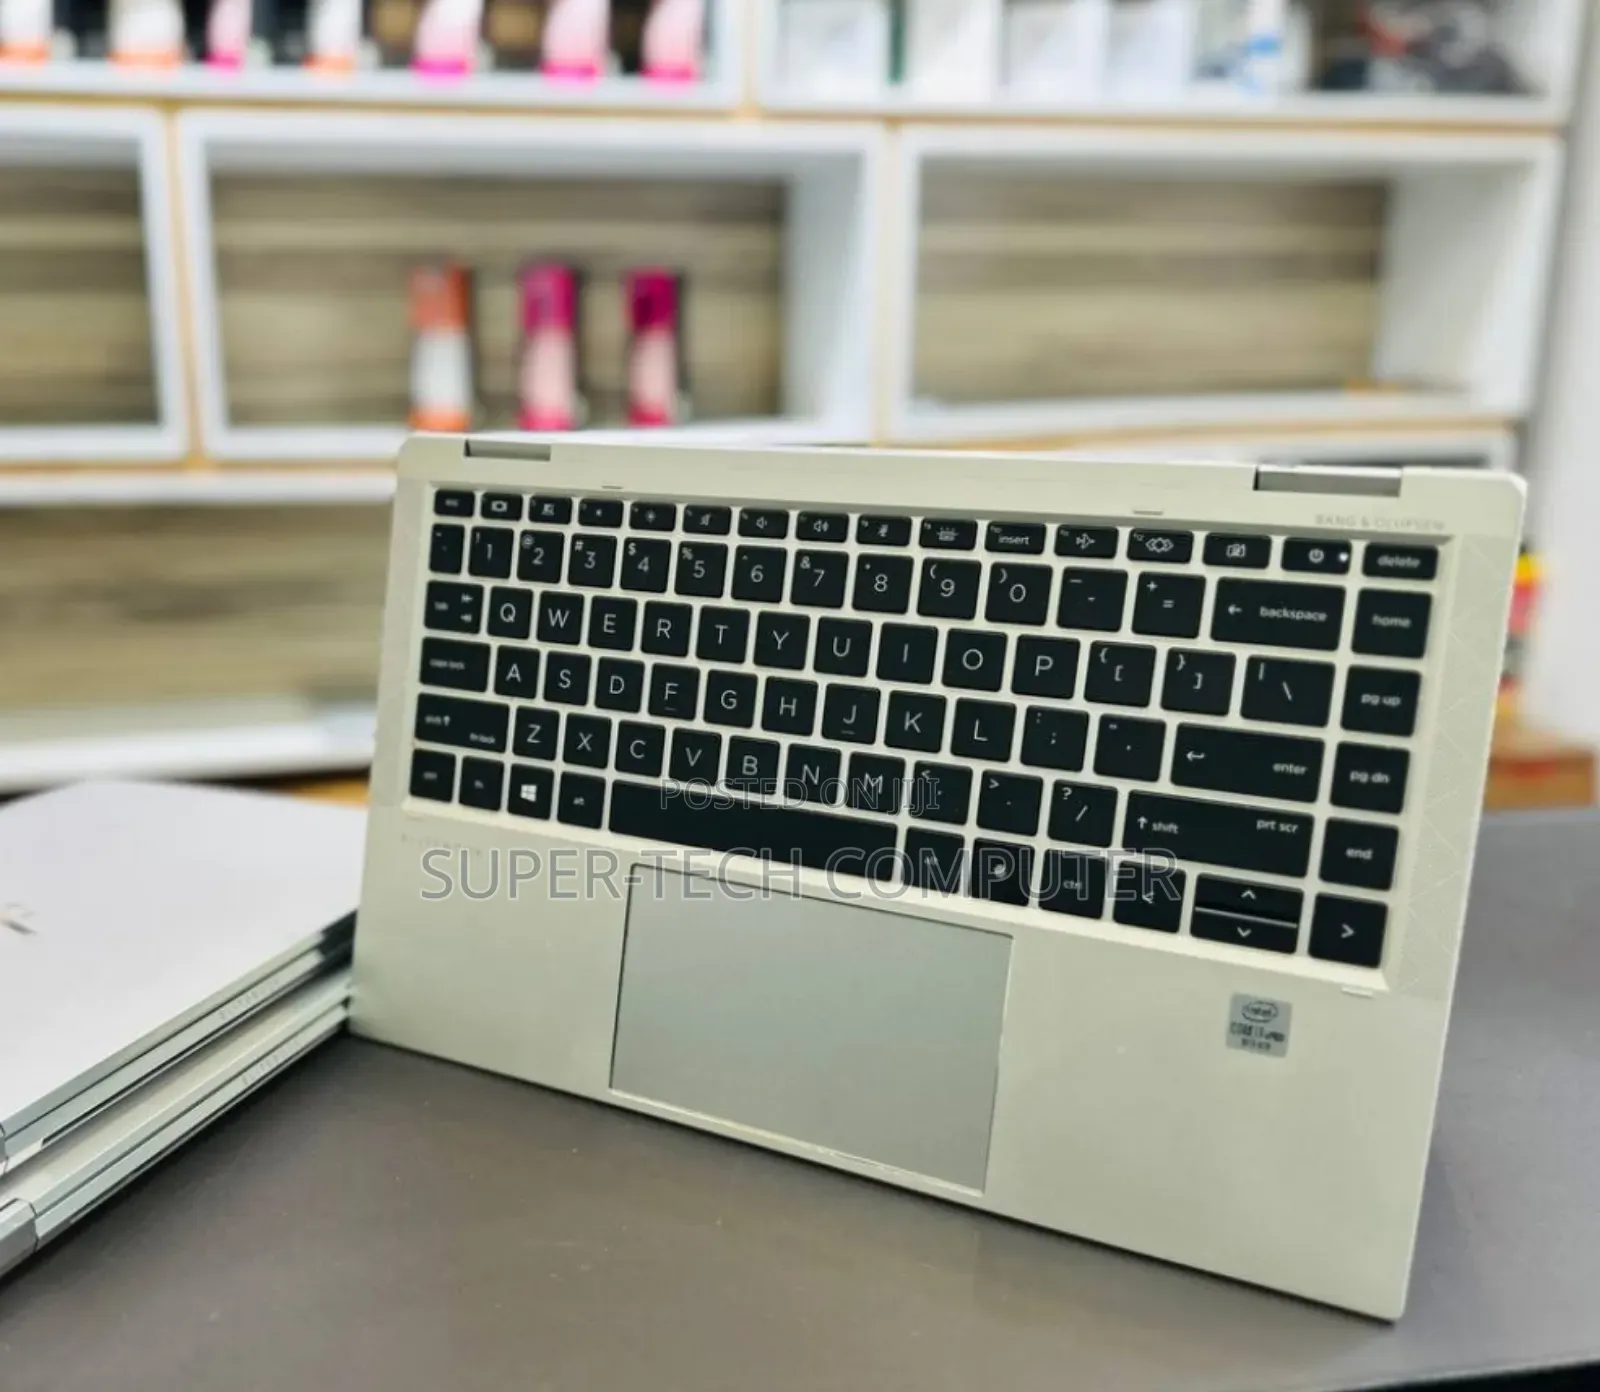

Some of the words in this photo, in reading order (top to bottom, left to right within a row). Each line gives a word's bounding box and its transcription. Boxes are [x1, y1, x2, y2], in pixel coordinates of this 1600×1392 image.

[997, 533, 1031, 546] insert
[487, 543, 493, 560] 1
[532, 547, 545, 565] 2
[584, 550, 596, 569] 3
[637, 556, 649, 573] 4
[690, 557, 706, 579] 5
[1377, 555, 1421, 569] delete
[750, 564, 764, 583] 6
[813, 569, 825, 587] 7
[873, 573, 888, 592] 8
[940, 578, 955, 597] 9
[499, 602, 516, 623] Q
[548, 608, 570, 629] W
[1259, 606, 1328, 622] backspace
[1372, 614, 1412, 628] home
[603, 613, 617, 634] E
[656, 618, 672, 639] R
[715, 624, 728, 645] T
[772, 630, 789, 650] Y
[832, 636, 851, 658] U
[962, 648, 984, 671] O
[1034, 655, 1054, 677] P
[506, 663, 521, 682] A
[558, 669, 571, 689] S
[609, 675, 625, 695] D
[664, 682, 679, 700] F
[720, 689, 737, 710] G
[779, 696, 797, 717] H
[1360, 693, 1381, 706] pg
[1381, 696, 1401, 707] up
[842, 704, 857, 725] J
[904, 711, 922, 733] K
[526, 723, 541, 744] Z
[973, 719, 988, 742] L
[577, 732, 593, 751] X
[629, 739, 646, 759] C
[685, 747, 703, 767] V
[742, 754, 758, 776] B
[801, 763, 821, 786] N
[1272, 763, 1307, 775] enter
[1349, 770, 1370, 784] pg
[1370, 772, 1390, 784] dn
[863, 772, 884, 794] M
[1062, 786, 1073, 800] ?
[1152, 821, 1179, 834] shift
[1256, 819, 1277, 831] prt
[1279, 823, 1299, 833] scr
[1345, 848, 1373, 860] end
